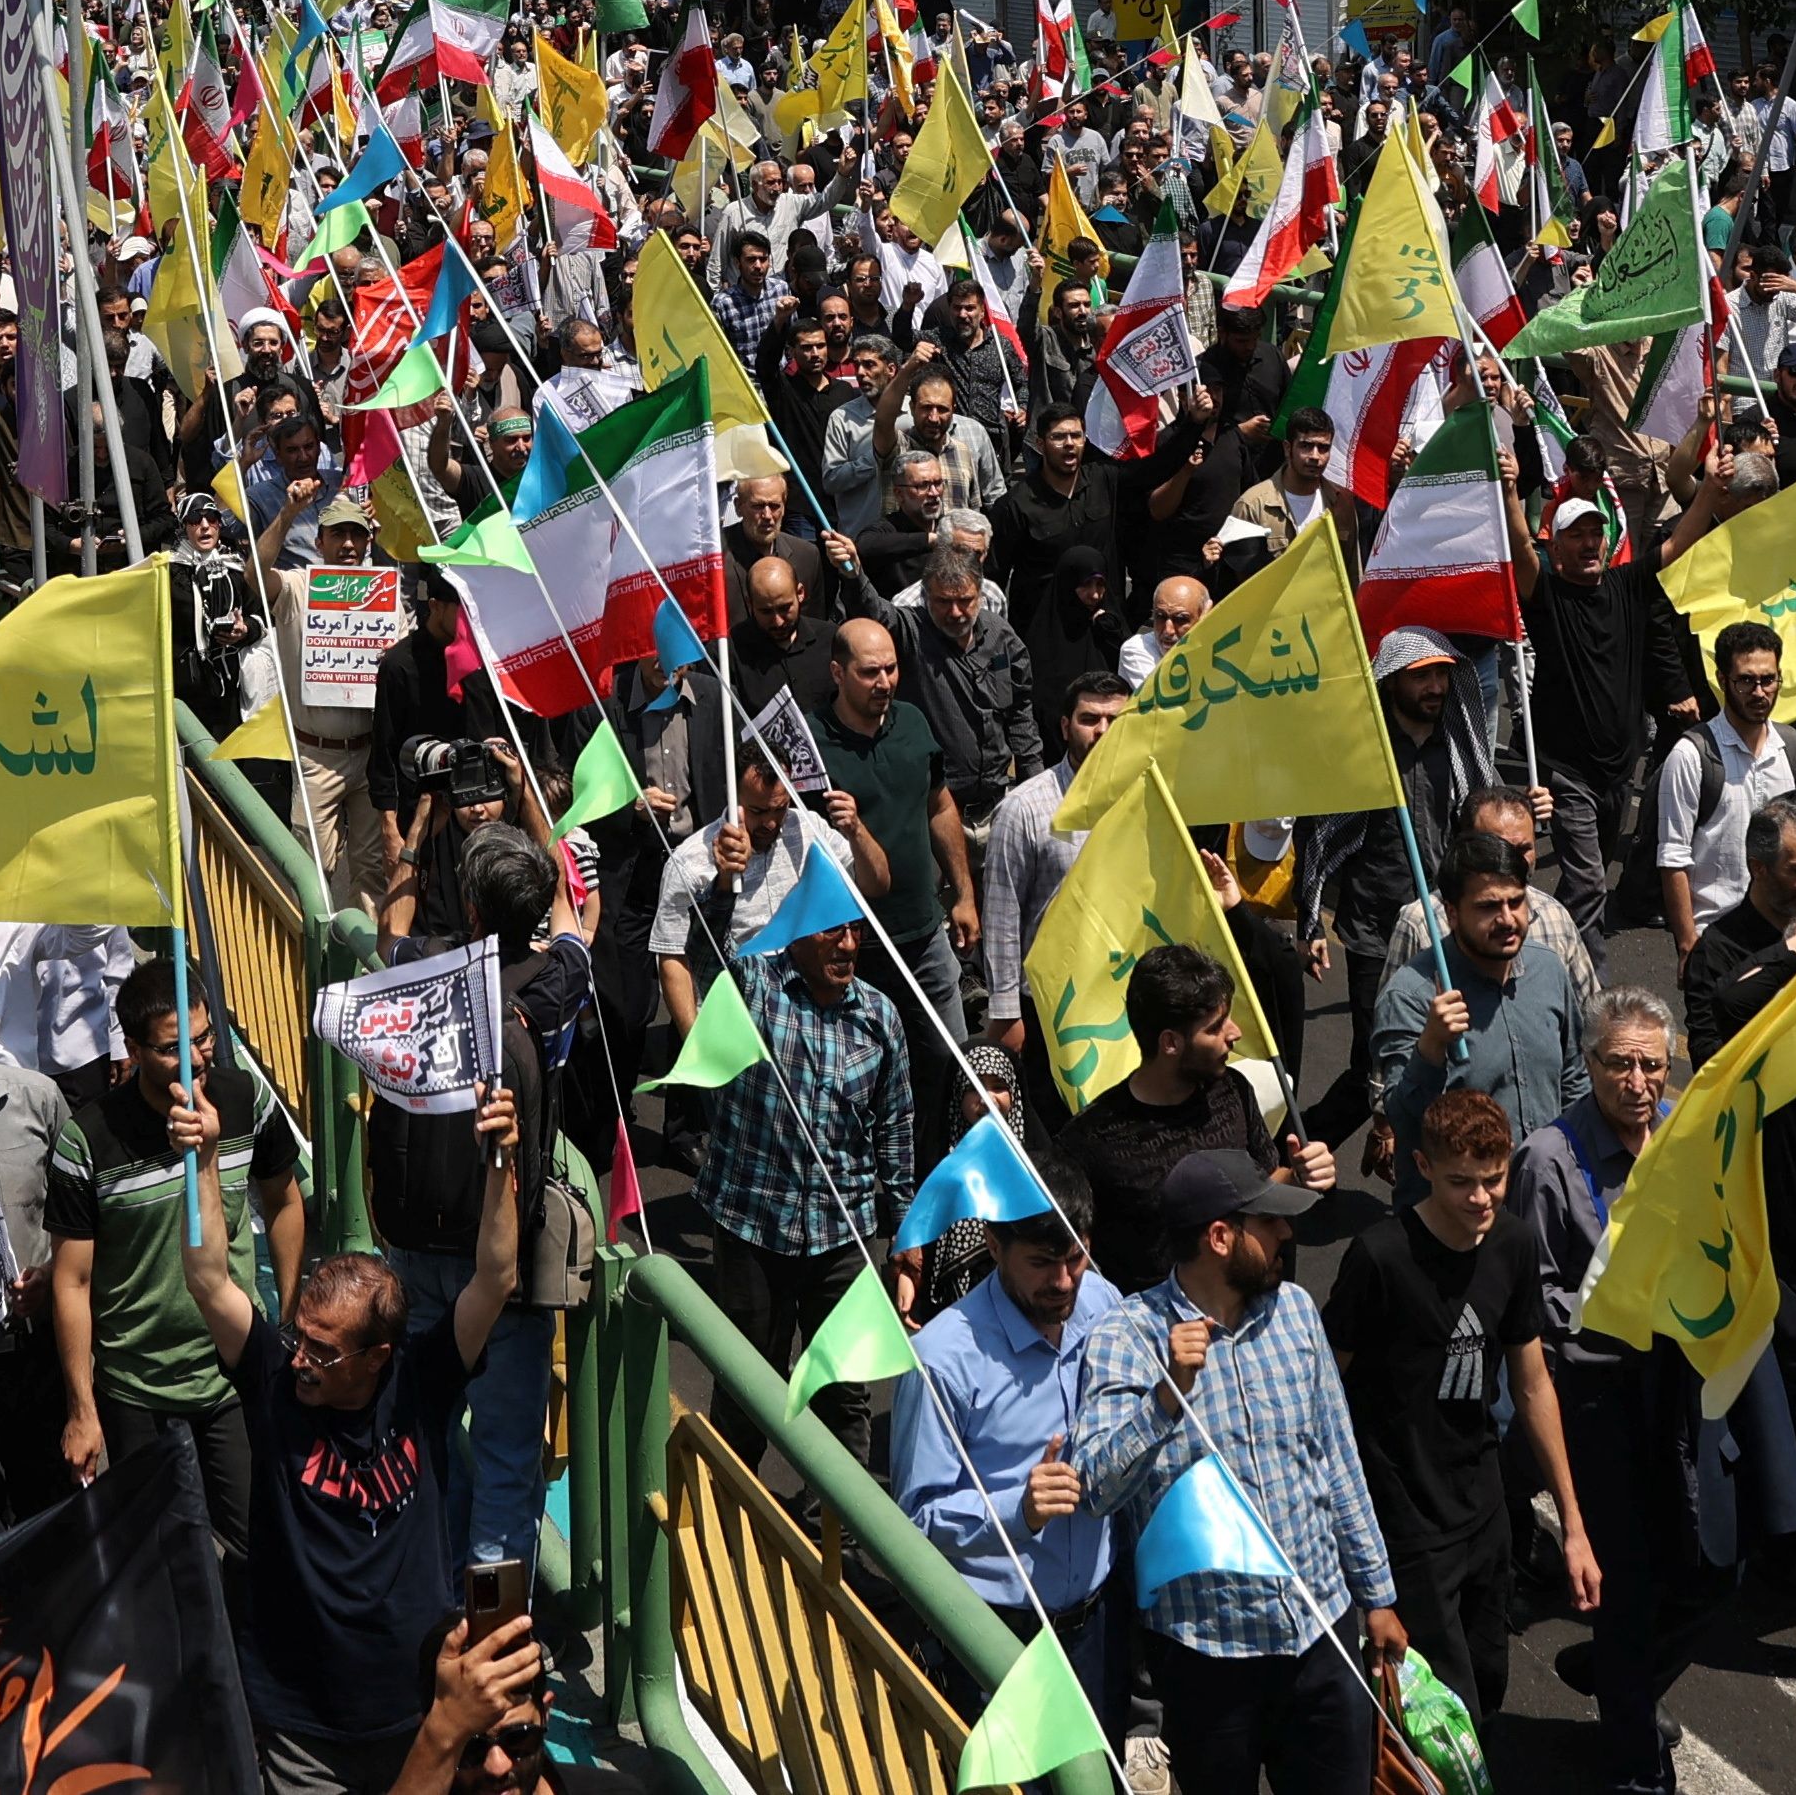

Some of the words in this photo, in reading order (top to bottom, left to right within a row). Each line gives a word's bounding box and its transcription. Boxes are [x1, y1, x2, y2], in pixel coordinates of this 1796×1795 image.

[307, 613, 351, 636] آمریکا
[350, 620, 364, 636] بر
[367, 616, 396, 637] مرگ
[306, 637, 337, 646] DOWN
[340, 638, 365, 647] WITH
[305, 648, 351, 669] اسرائیل
[352, 655, 364, 669] بر
[306, 672, 333, 681] DOWN
[335, 673, 359, 682] WITH
[360, 674, 377, 683] ISR
[1179, 611, 1322, 732] لشکر
